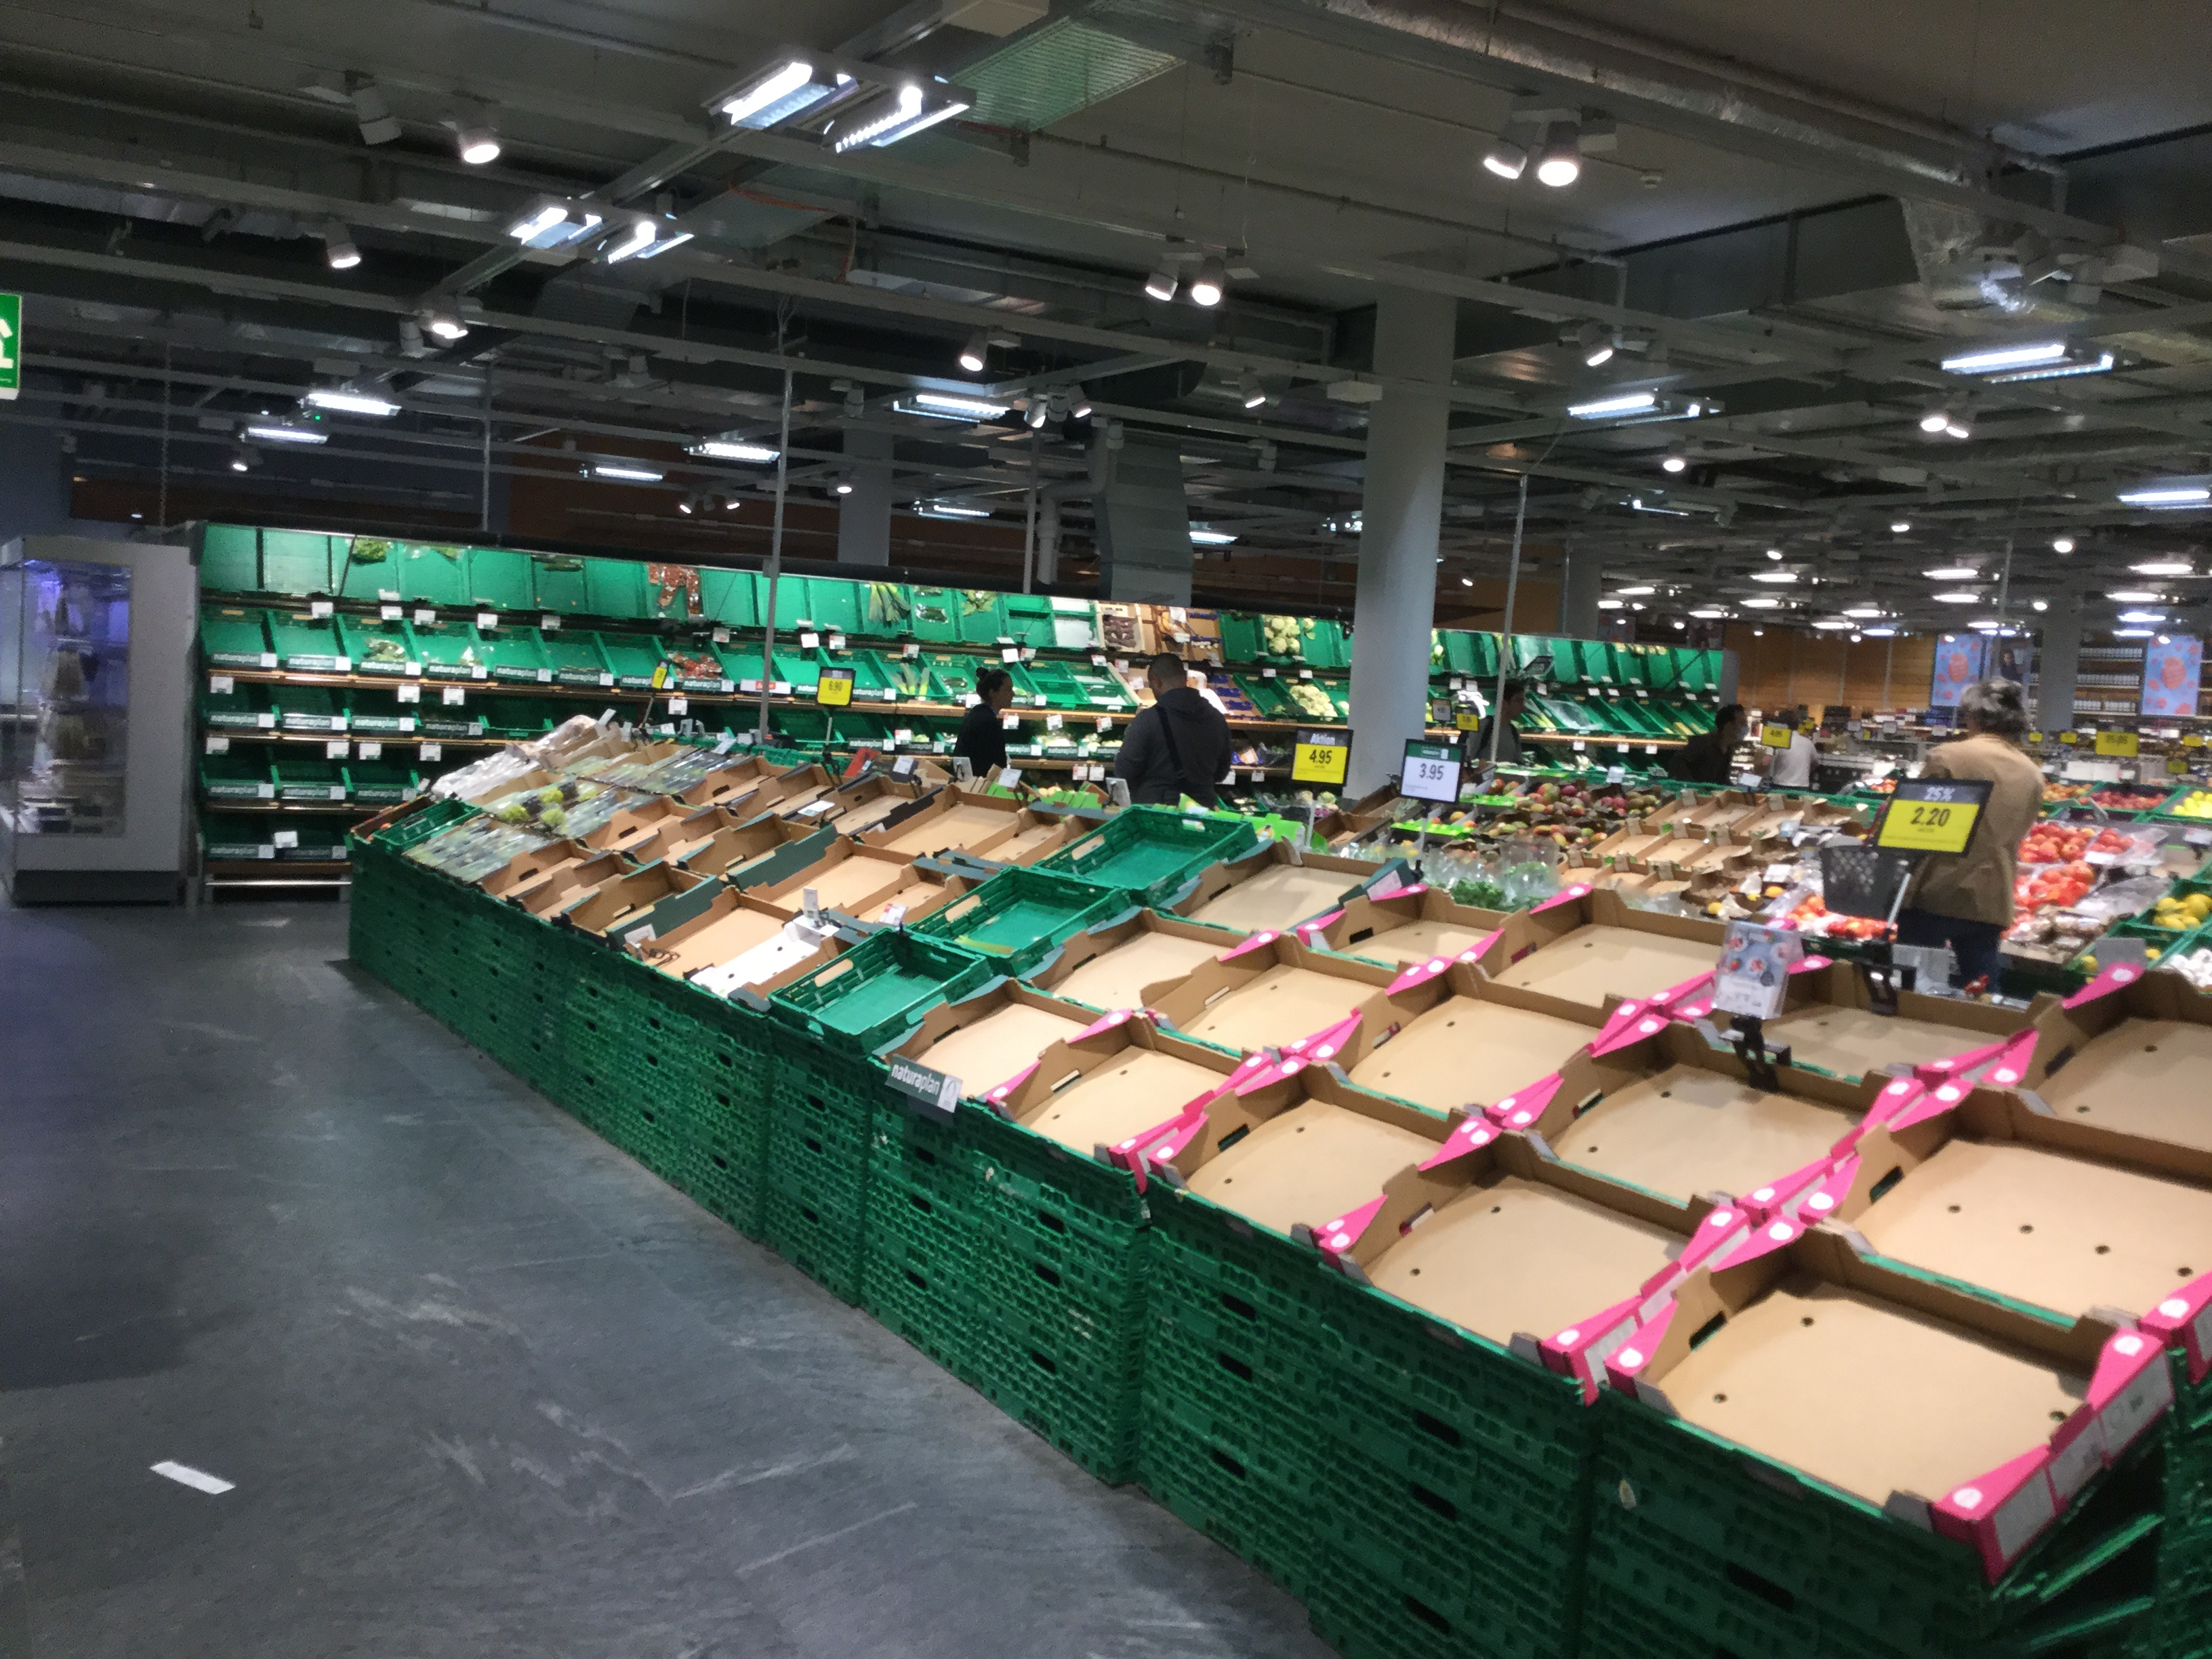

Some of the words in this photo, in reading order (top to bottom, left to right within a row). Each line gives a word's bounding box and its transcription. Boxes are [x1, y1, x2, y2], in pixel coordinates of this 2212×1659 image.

[1309, 749, 1332, 764] 4.95
[1419, 763, 1444, 780] 3.95
[1910, 806, 1952, 827] 2.20
[891, 1064, 941, 1096] naturaplan
